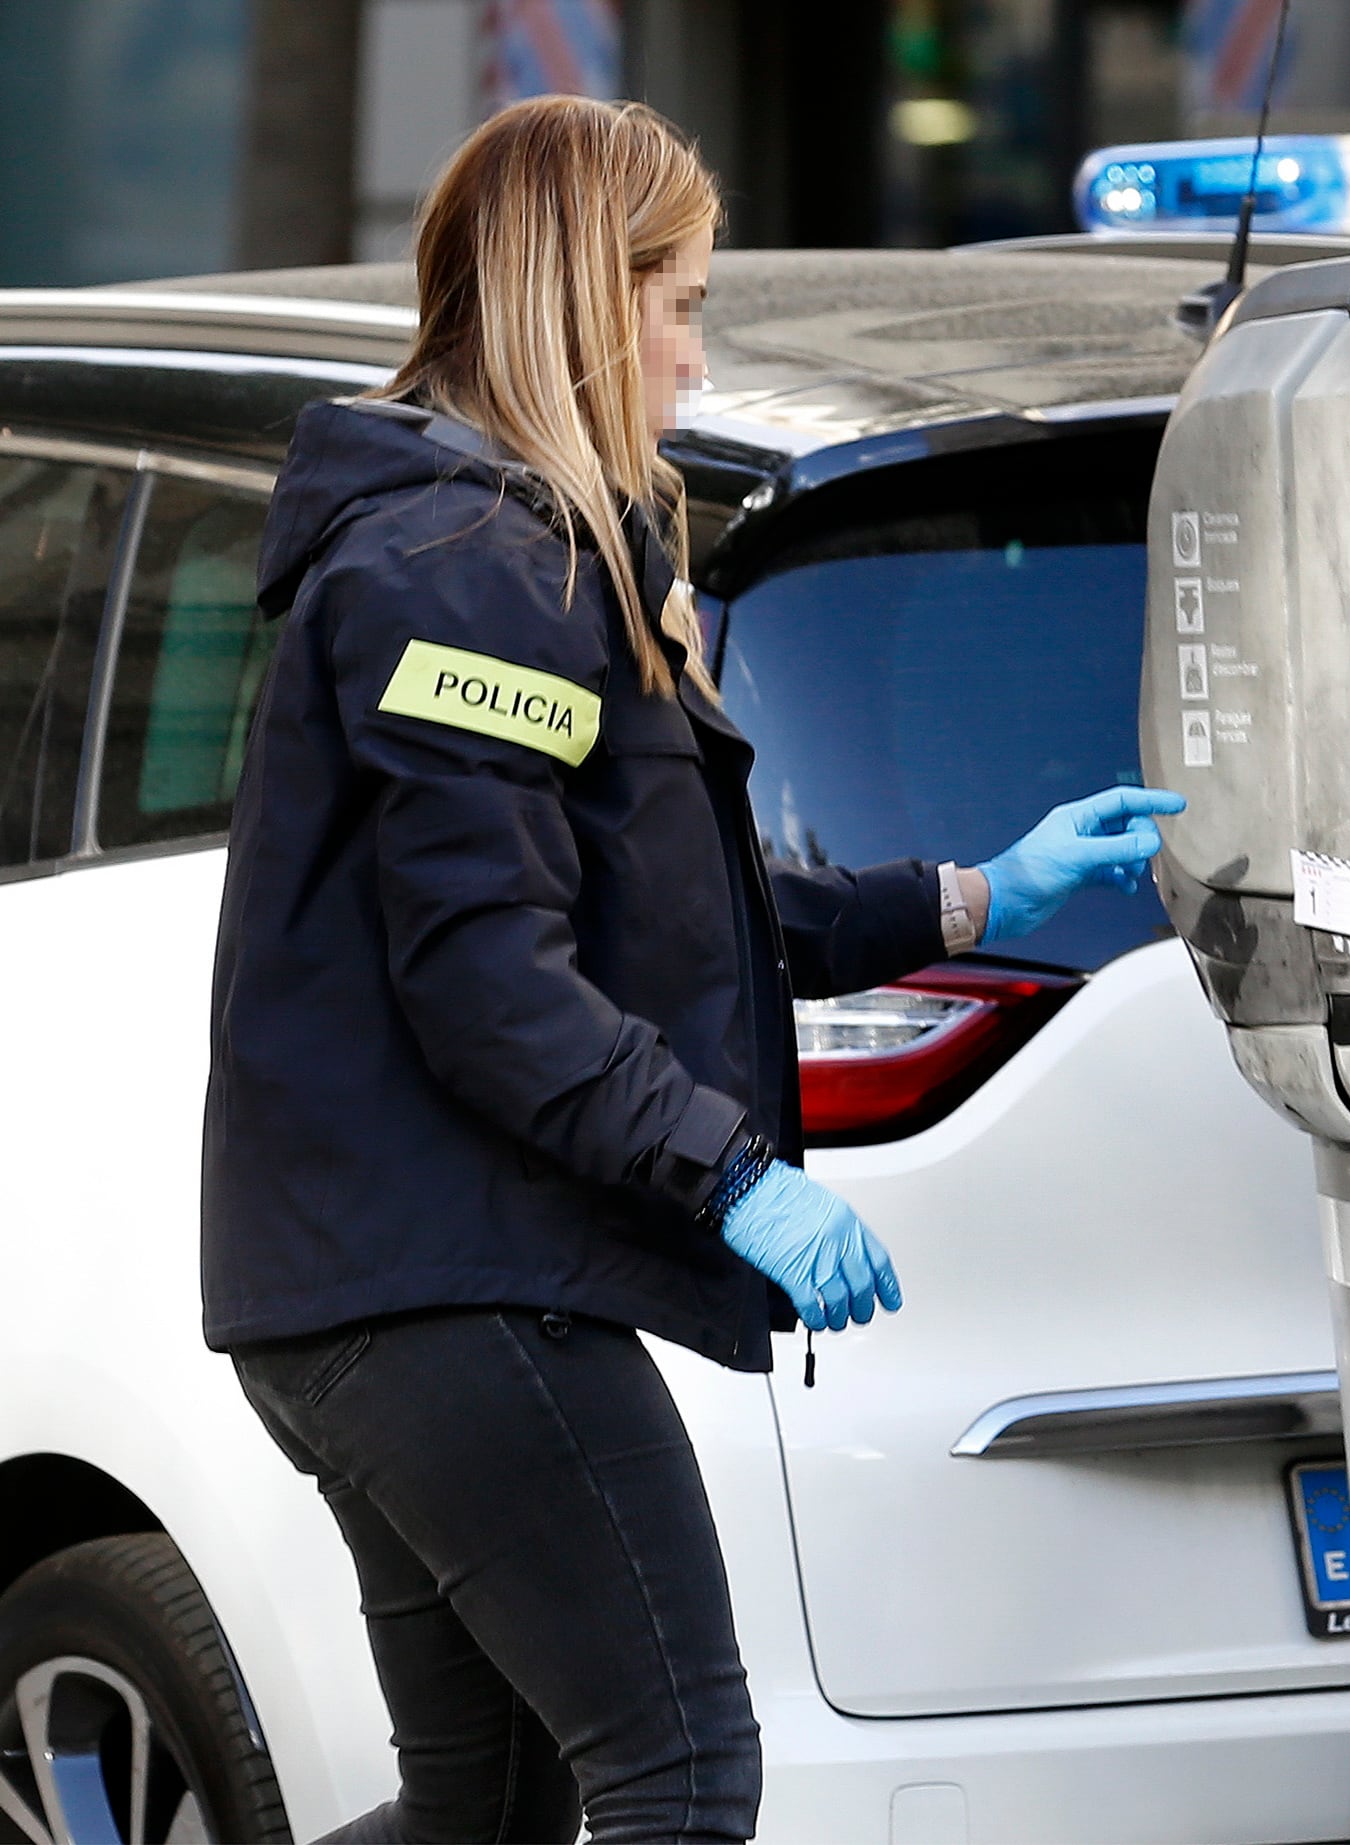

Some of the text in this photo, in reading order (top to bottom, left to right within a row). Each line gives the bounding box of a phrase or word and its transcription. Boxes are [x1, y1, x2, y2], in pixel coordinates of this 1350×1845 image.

[433, 670, 575, 739] POLICIA
[1309, 886, 1317, 916] 1
[1323, 1551, 1350, 1582] E
